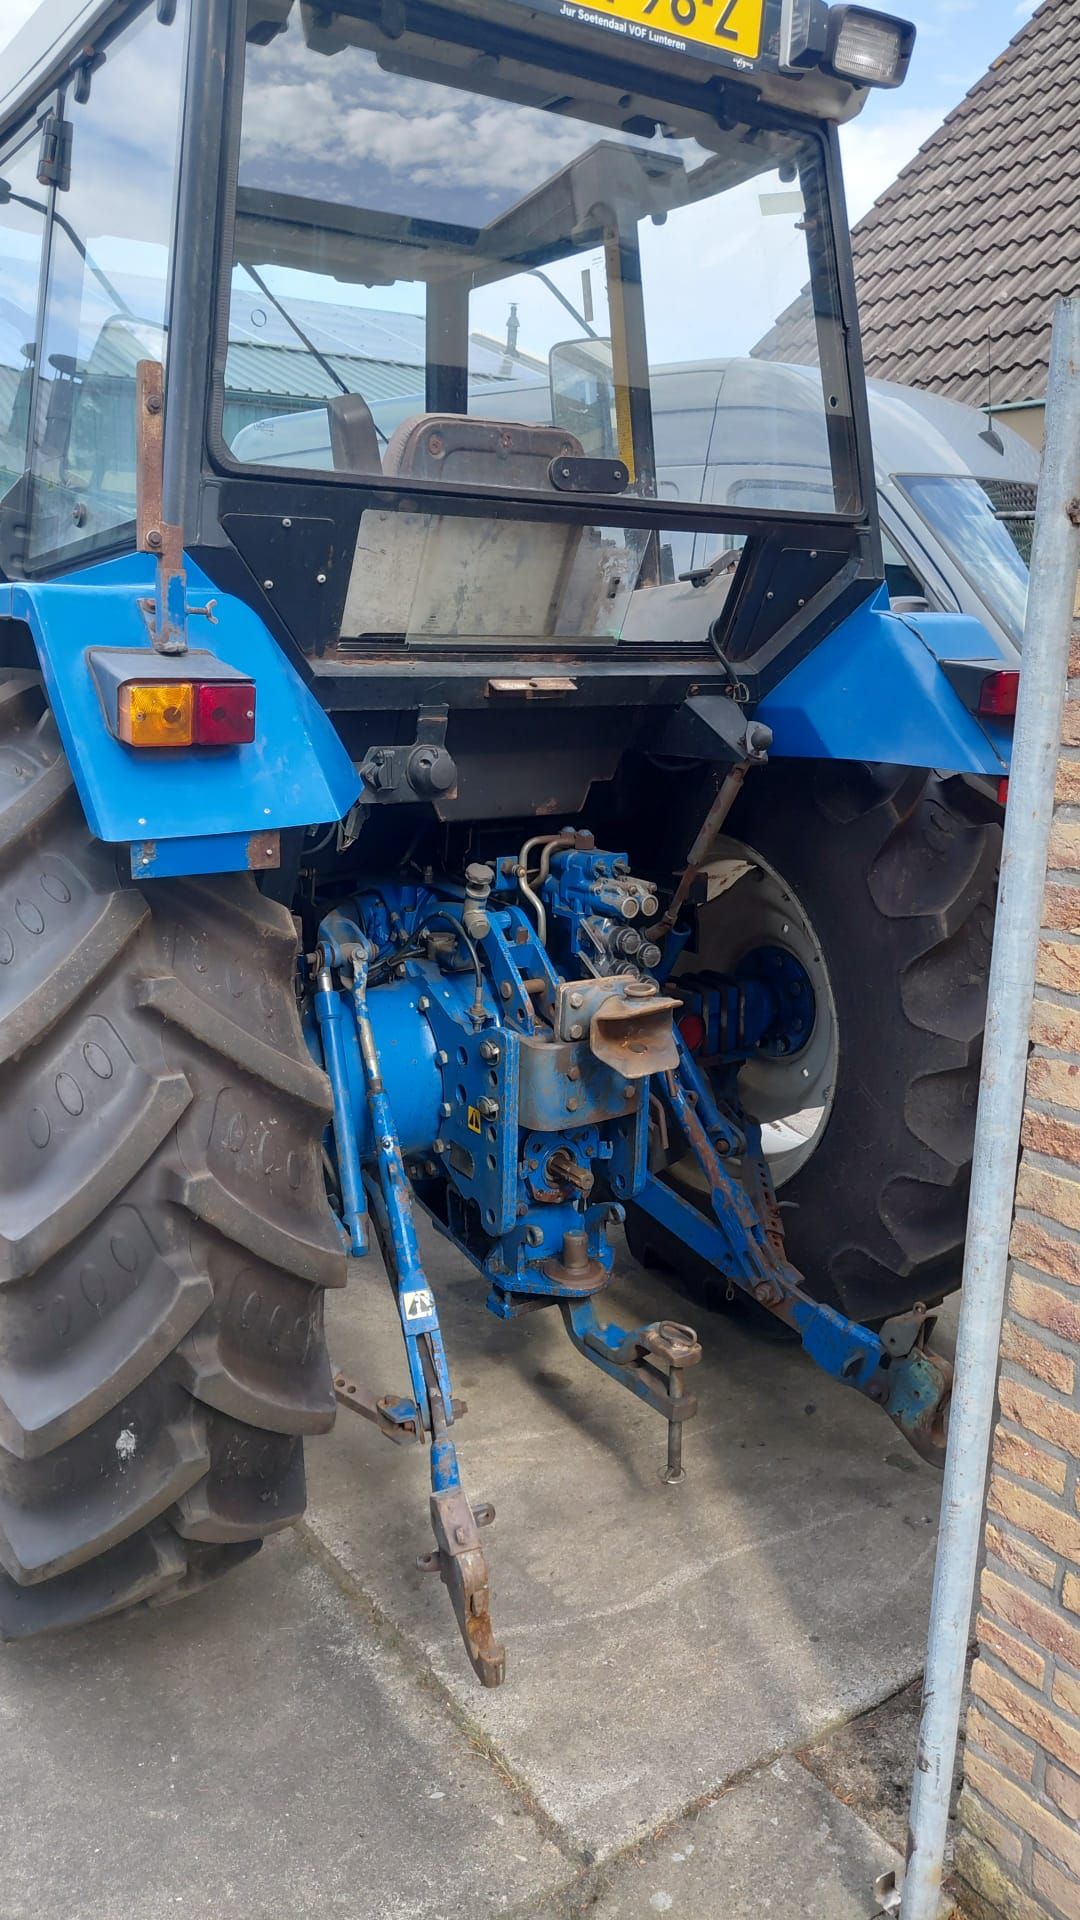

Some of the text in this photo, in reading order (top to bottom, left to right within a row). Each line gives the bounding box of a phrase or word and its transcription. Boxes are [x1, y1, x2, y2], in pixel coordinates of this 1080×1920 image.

[559, 4, 687, 51] Jur Soetendaal VOF Lunteren
